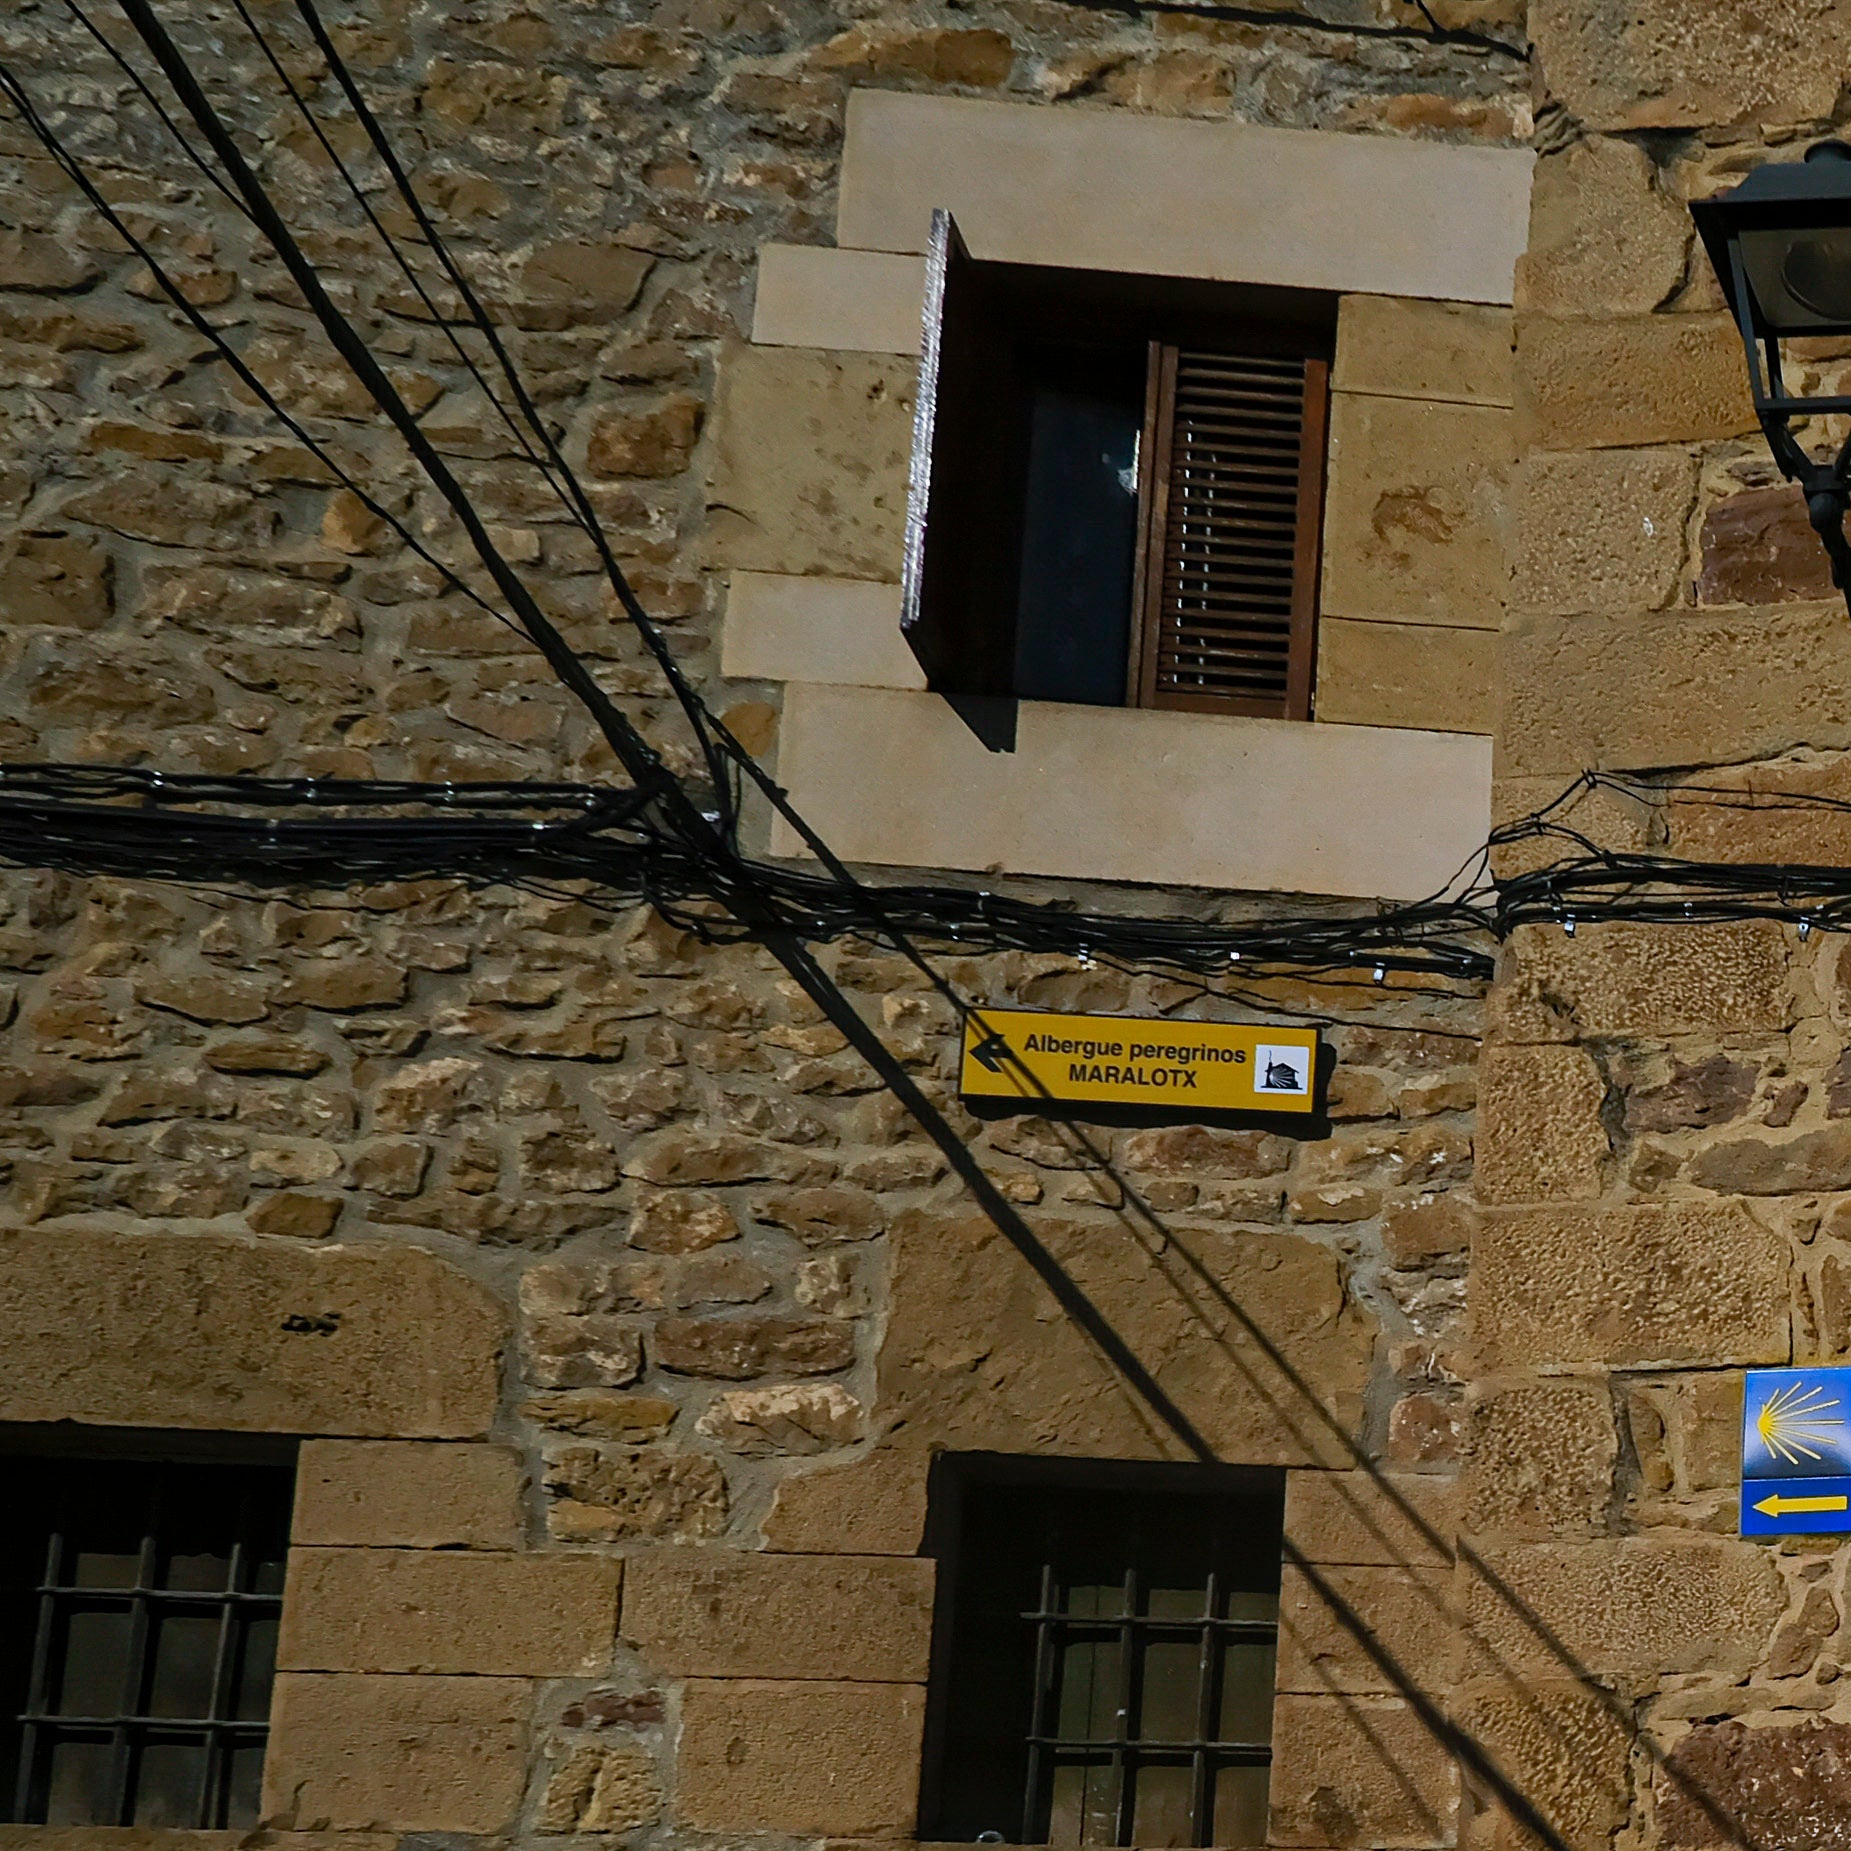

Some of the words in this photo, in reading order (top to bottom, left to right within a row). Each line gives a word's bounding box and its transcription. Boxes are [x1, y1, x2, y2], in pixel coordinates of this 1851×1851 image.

[1024, 1033, 1123, 1060] Albergue
[1129, 1043, 1247, 1065] peregrinos
[1069, 1063, 1198, 1089] MARALOTX
